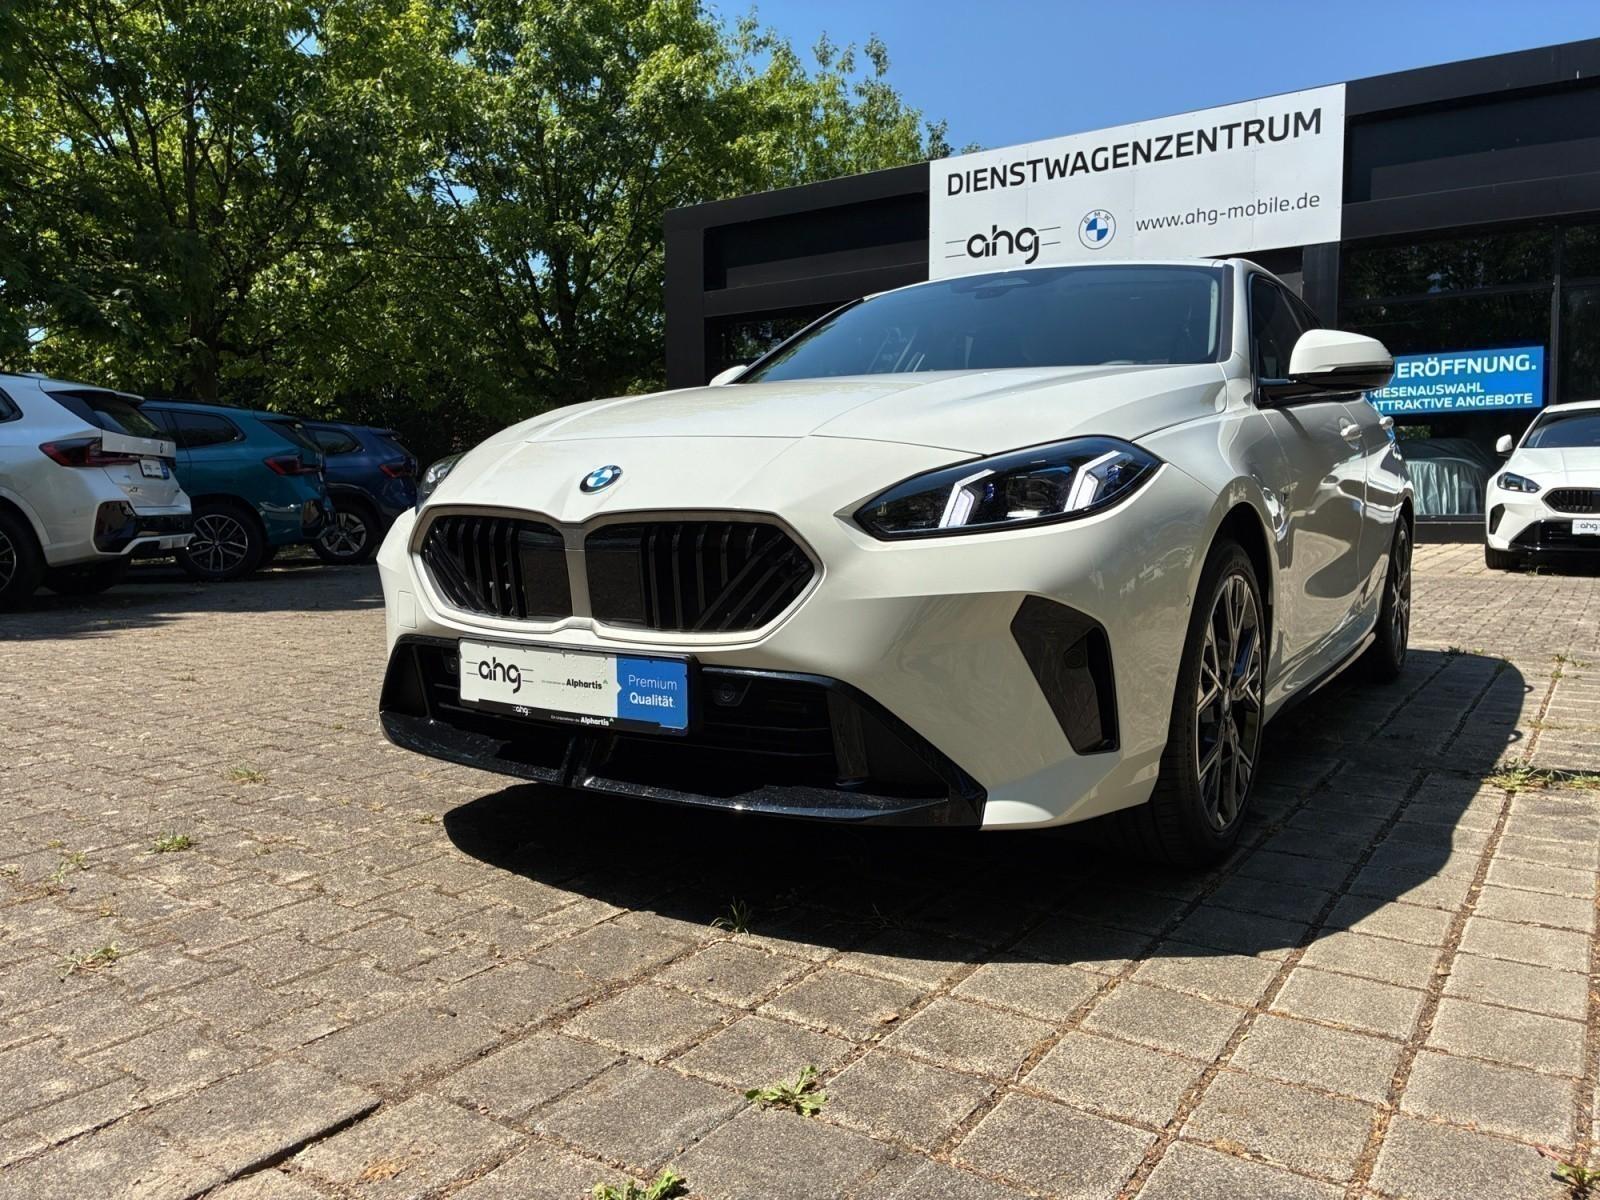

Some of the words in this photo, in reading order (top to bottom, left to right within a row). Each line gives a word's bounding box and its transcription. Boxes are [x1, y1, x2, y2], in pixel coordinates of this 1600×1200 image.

[947, 107, 1322, 196] DIENSTWAGENZENTRUM
[1136, 192, 1321, 233] www.ahg-mobile.de
[966, 224, 1040, 265] ahg
[1396, 354, 1537, 379] ERÖFFNUNG.
[1455, 392, 1533, 408] ANGEBOTE
[1580, 522, 1598, 532] ahg
[478, 657, 522, 694] ahg
[566, 678, 603, 690] Alphartis
[628, 674, 678, 691] Premium
[515, 705, 529, 717] ahg
[580, 716, 610, 727] Alphartis
